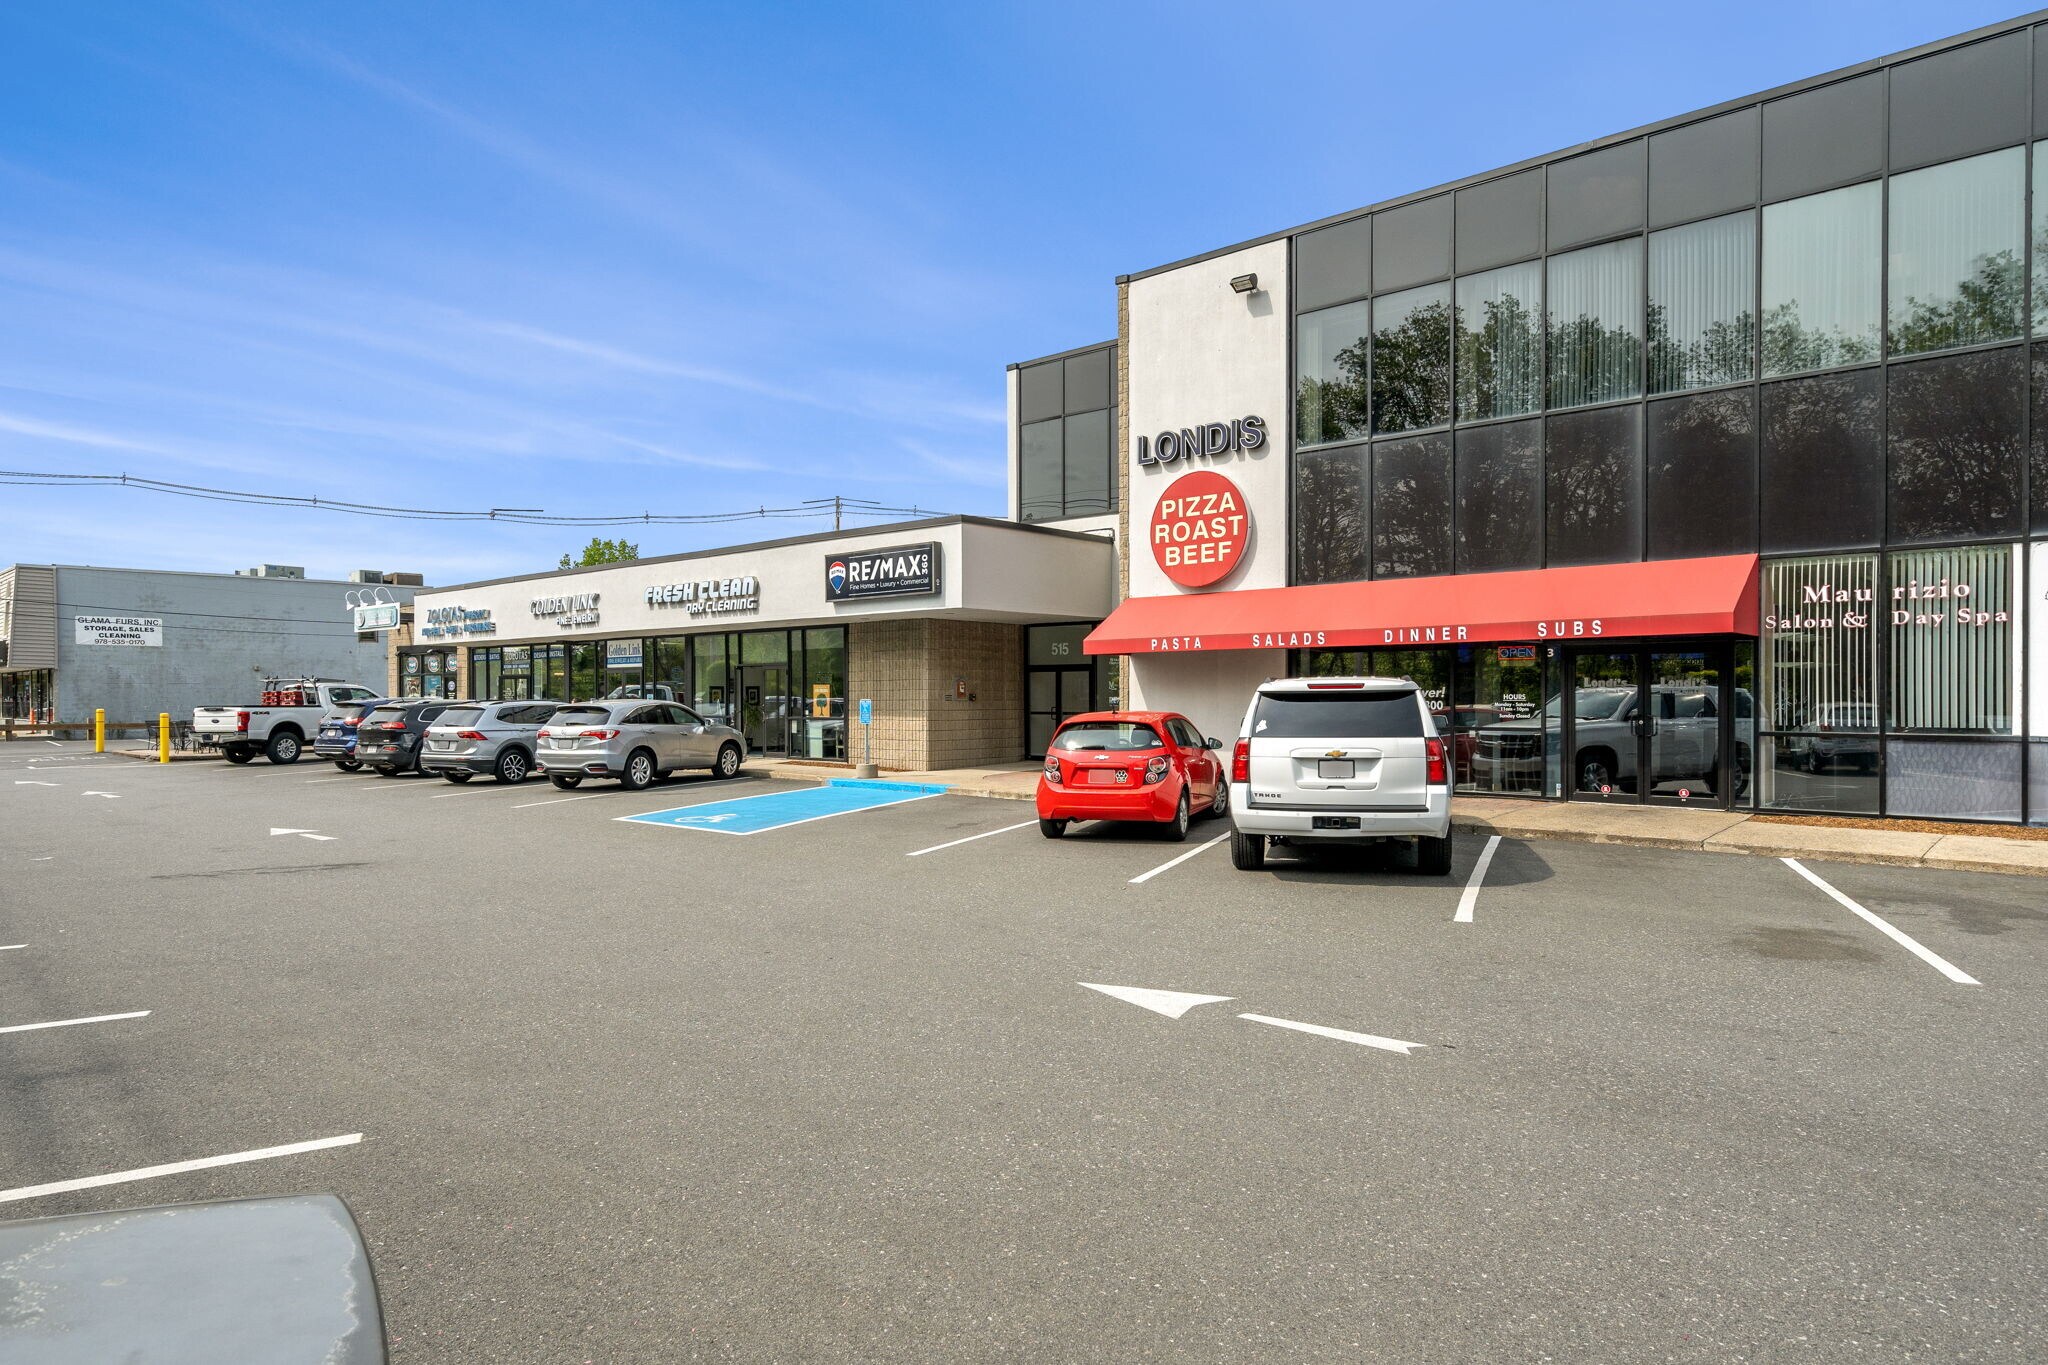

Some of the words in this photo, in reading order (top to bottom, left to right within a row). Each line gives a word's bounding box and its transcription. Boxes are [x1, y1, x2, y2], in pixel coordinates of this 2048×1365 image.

[1137, 415, 1265, 466] LONDIS
[1161, 491, 1236, 520] PIZZA
[1155, 515, 1244, 544] ROAST
[921, 553, 929, 575] 360
[1165, 541, 1233, 567] BEEF
[849, 554, 922, 582] RE/MAX
[644, 582, 695, 603] FRESH
[698, 576, 758, 599] CLEAN
[900, 577, 929, 586] Commercial
[529, 597, 570, 615] GOLDEN
[572, 593, 600, 612] LINK
[685, 600, 704, 613] DRY
[705, 598, 756, 612] CLEANING
[77, 616, 111, 624] GLAMA
[1765, 614, 1833, 629] Salon
[1842, 611, 1868, 628] &
[1891, 610, 1946, 628] Day
[1957, 607, 2009, 627] Spa
[1151, 637, 1202, 651] PASTA
[1252, 631, 1326, 648] SALADS
[1384, 626, 1468, 643] DINNER
[1537, 619, 1603, 638] SUBS
[608, 643, 628, 656] Golden
[628, 642, 642, 656] Link
[1051, 642, 1069, 656] 515
[1499, 647, 1536, 659] OPEN
[1546, 648, 1554, 657] 3
[1583, 676, 1628, 688] Londi's
[1660, 676, 1707, 688] Londi's
